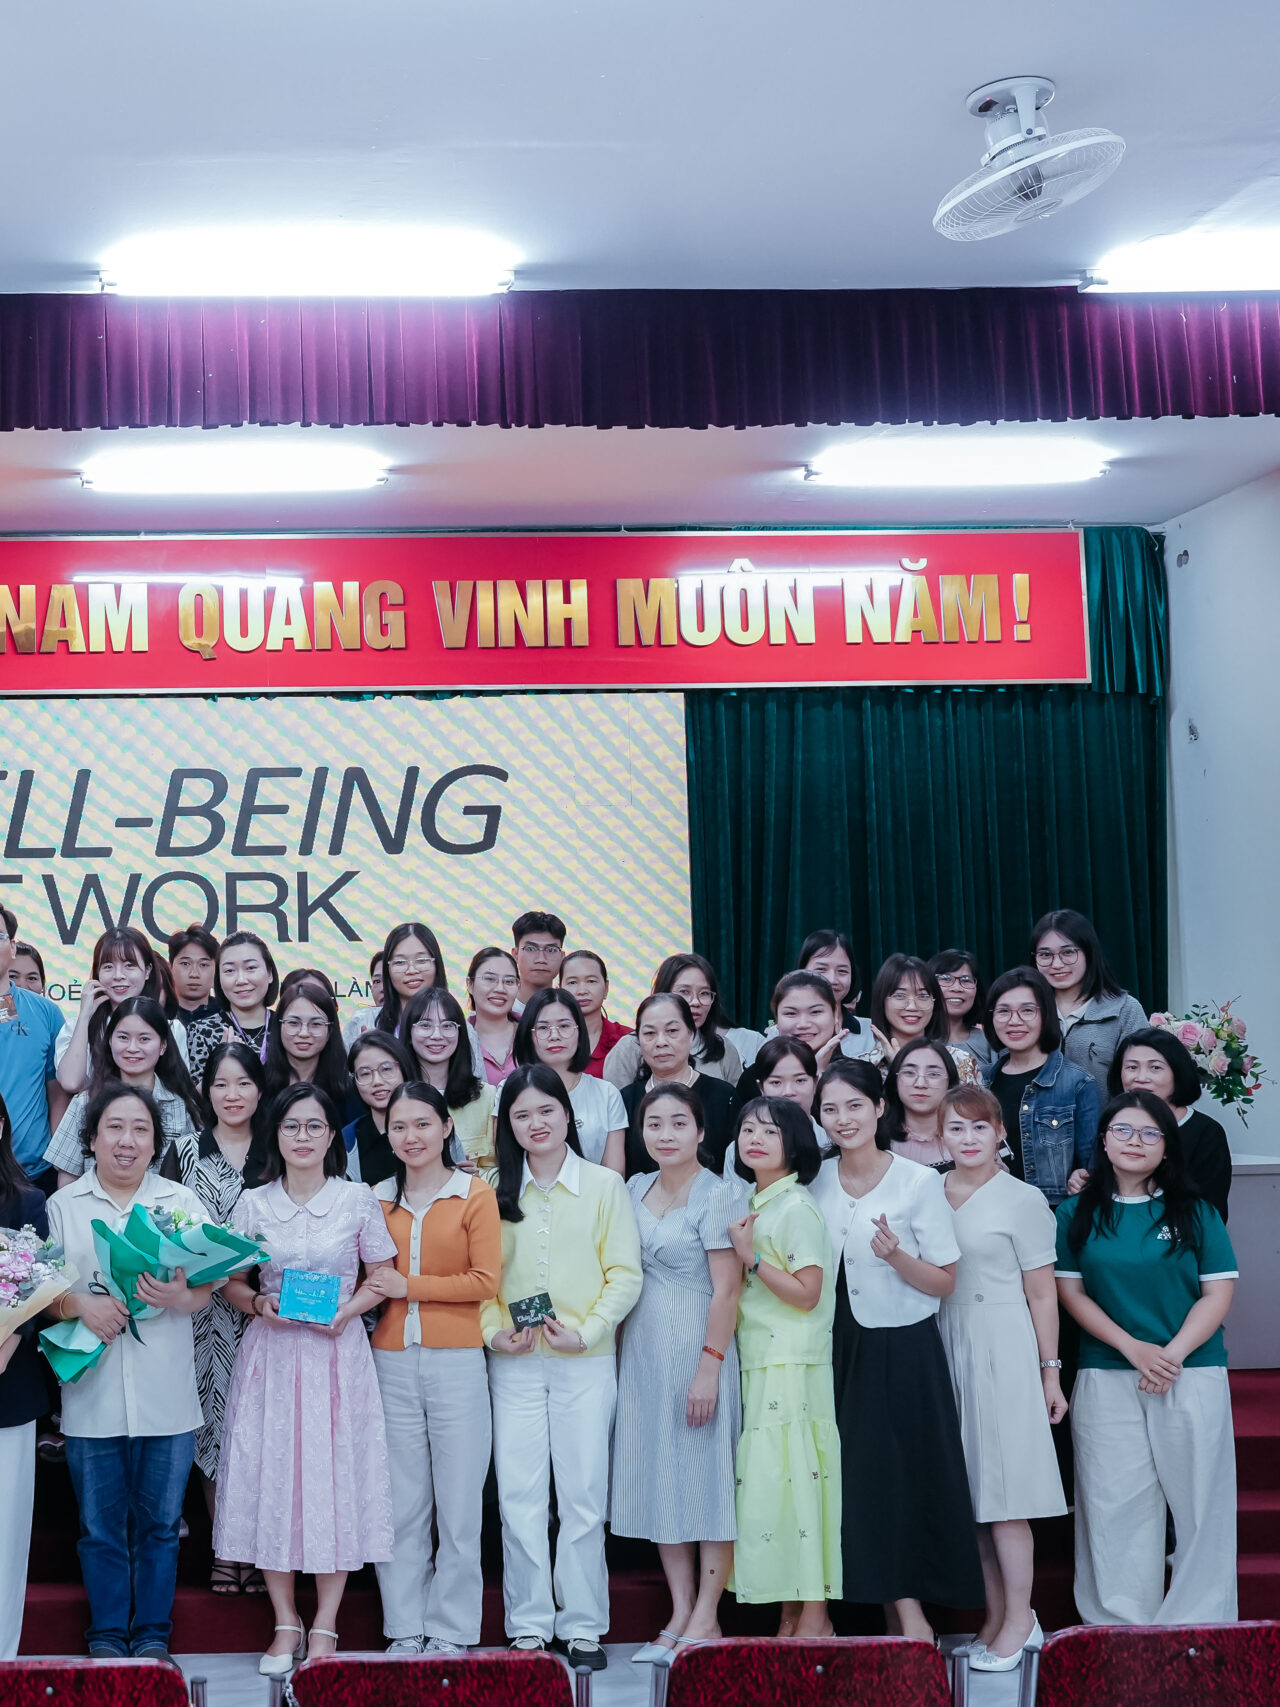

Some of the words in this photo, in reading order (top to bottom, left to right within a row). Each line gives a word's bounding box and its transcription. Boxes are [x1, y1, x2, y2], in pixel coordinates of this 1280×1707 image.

[177, 579, 407, 660] QUANG
[431, 578, 589, 648] VINH
[616, 558, 816, 647] MUÔN
[41, 870, 363, 946] WORK
